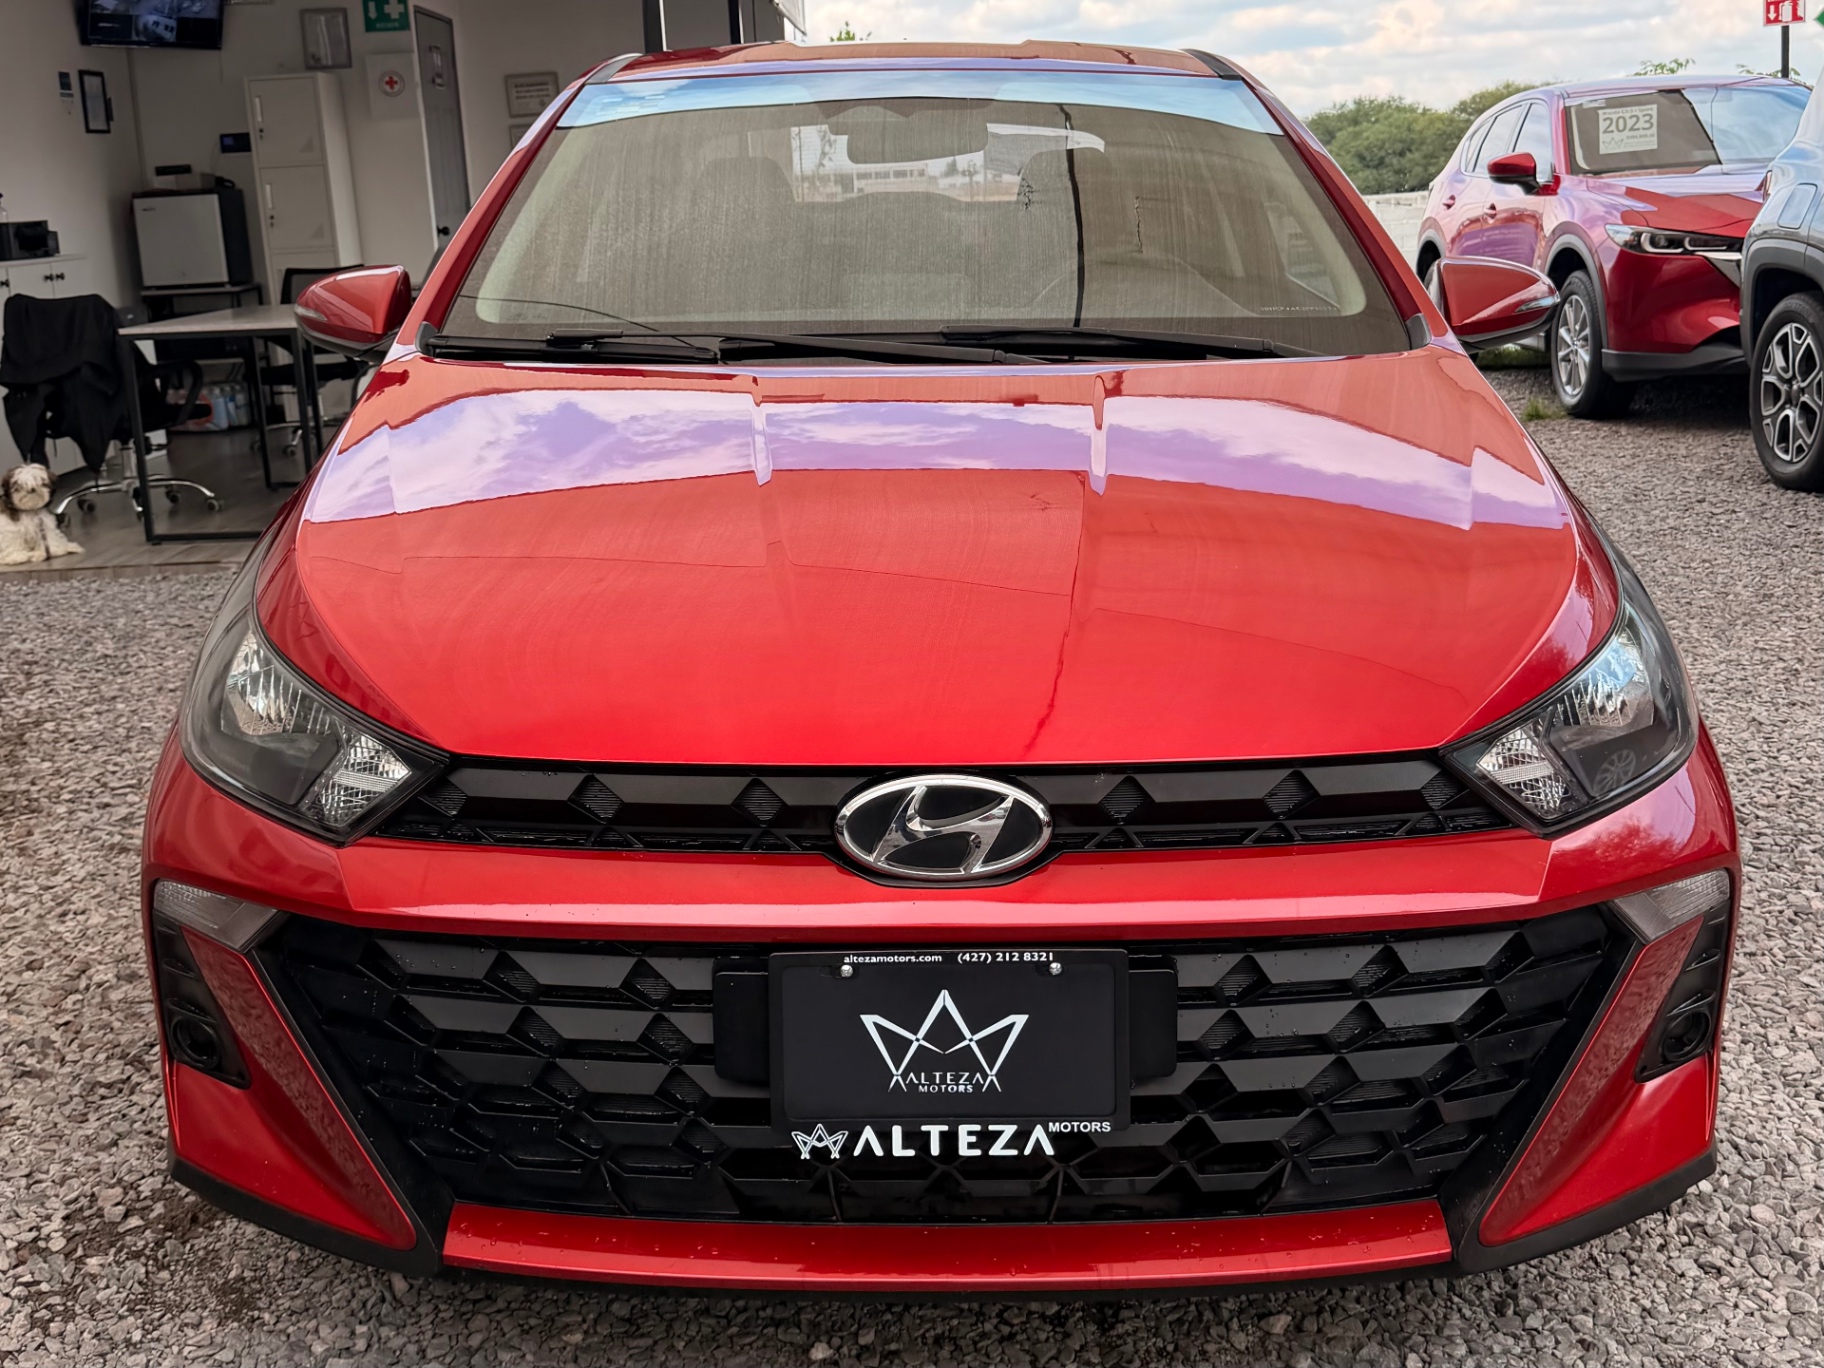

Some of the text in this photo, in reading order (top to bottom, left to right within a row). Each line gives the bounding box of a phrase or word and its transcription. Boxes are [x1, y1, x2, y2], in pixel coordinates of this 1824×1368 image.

[1602, 113, 1654, 134] 2023
[843, 952, 1053, 964] altezamotors.com (427) 212 8321
[905, 1072, 984, 1084] ALTEZA
[918, 1085, 974, 1093] MOTORS
[853, 1121, 1111, 1156] ALTEZA MOTORS
